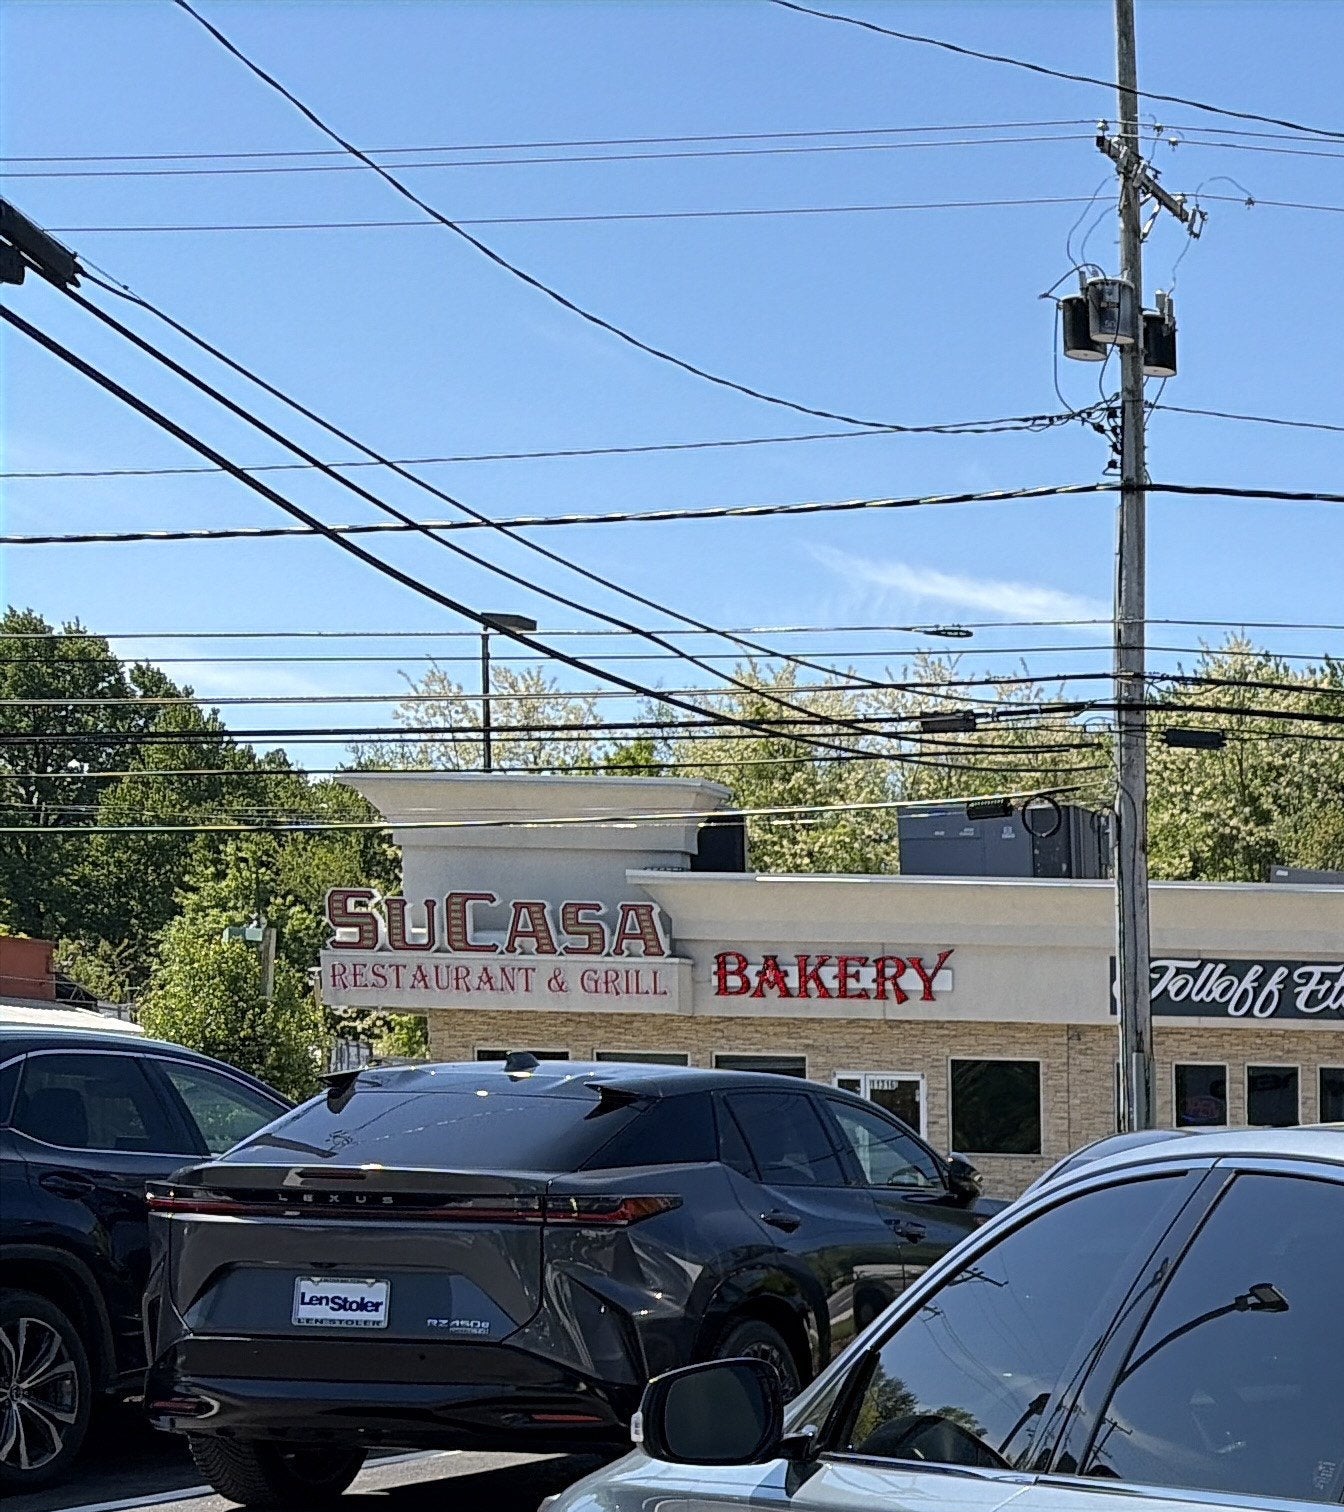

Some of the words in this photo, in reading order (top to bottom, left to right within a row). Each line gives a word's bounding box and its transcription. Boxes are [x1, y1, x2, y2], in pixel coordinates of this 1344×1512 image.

[330, 962, 536, 993] RESTAURANT
[547, 967, 569, 993] &
[580, 968, 668, 997] GRILL
[713, 949, 955, 1005] BAKERY
[278, 1193, 394, 1204] LEXUS
